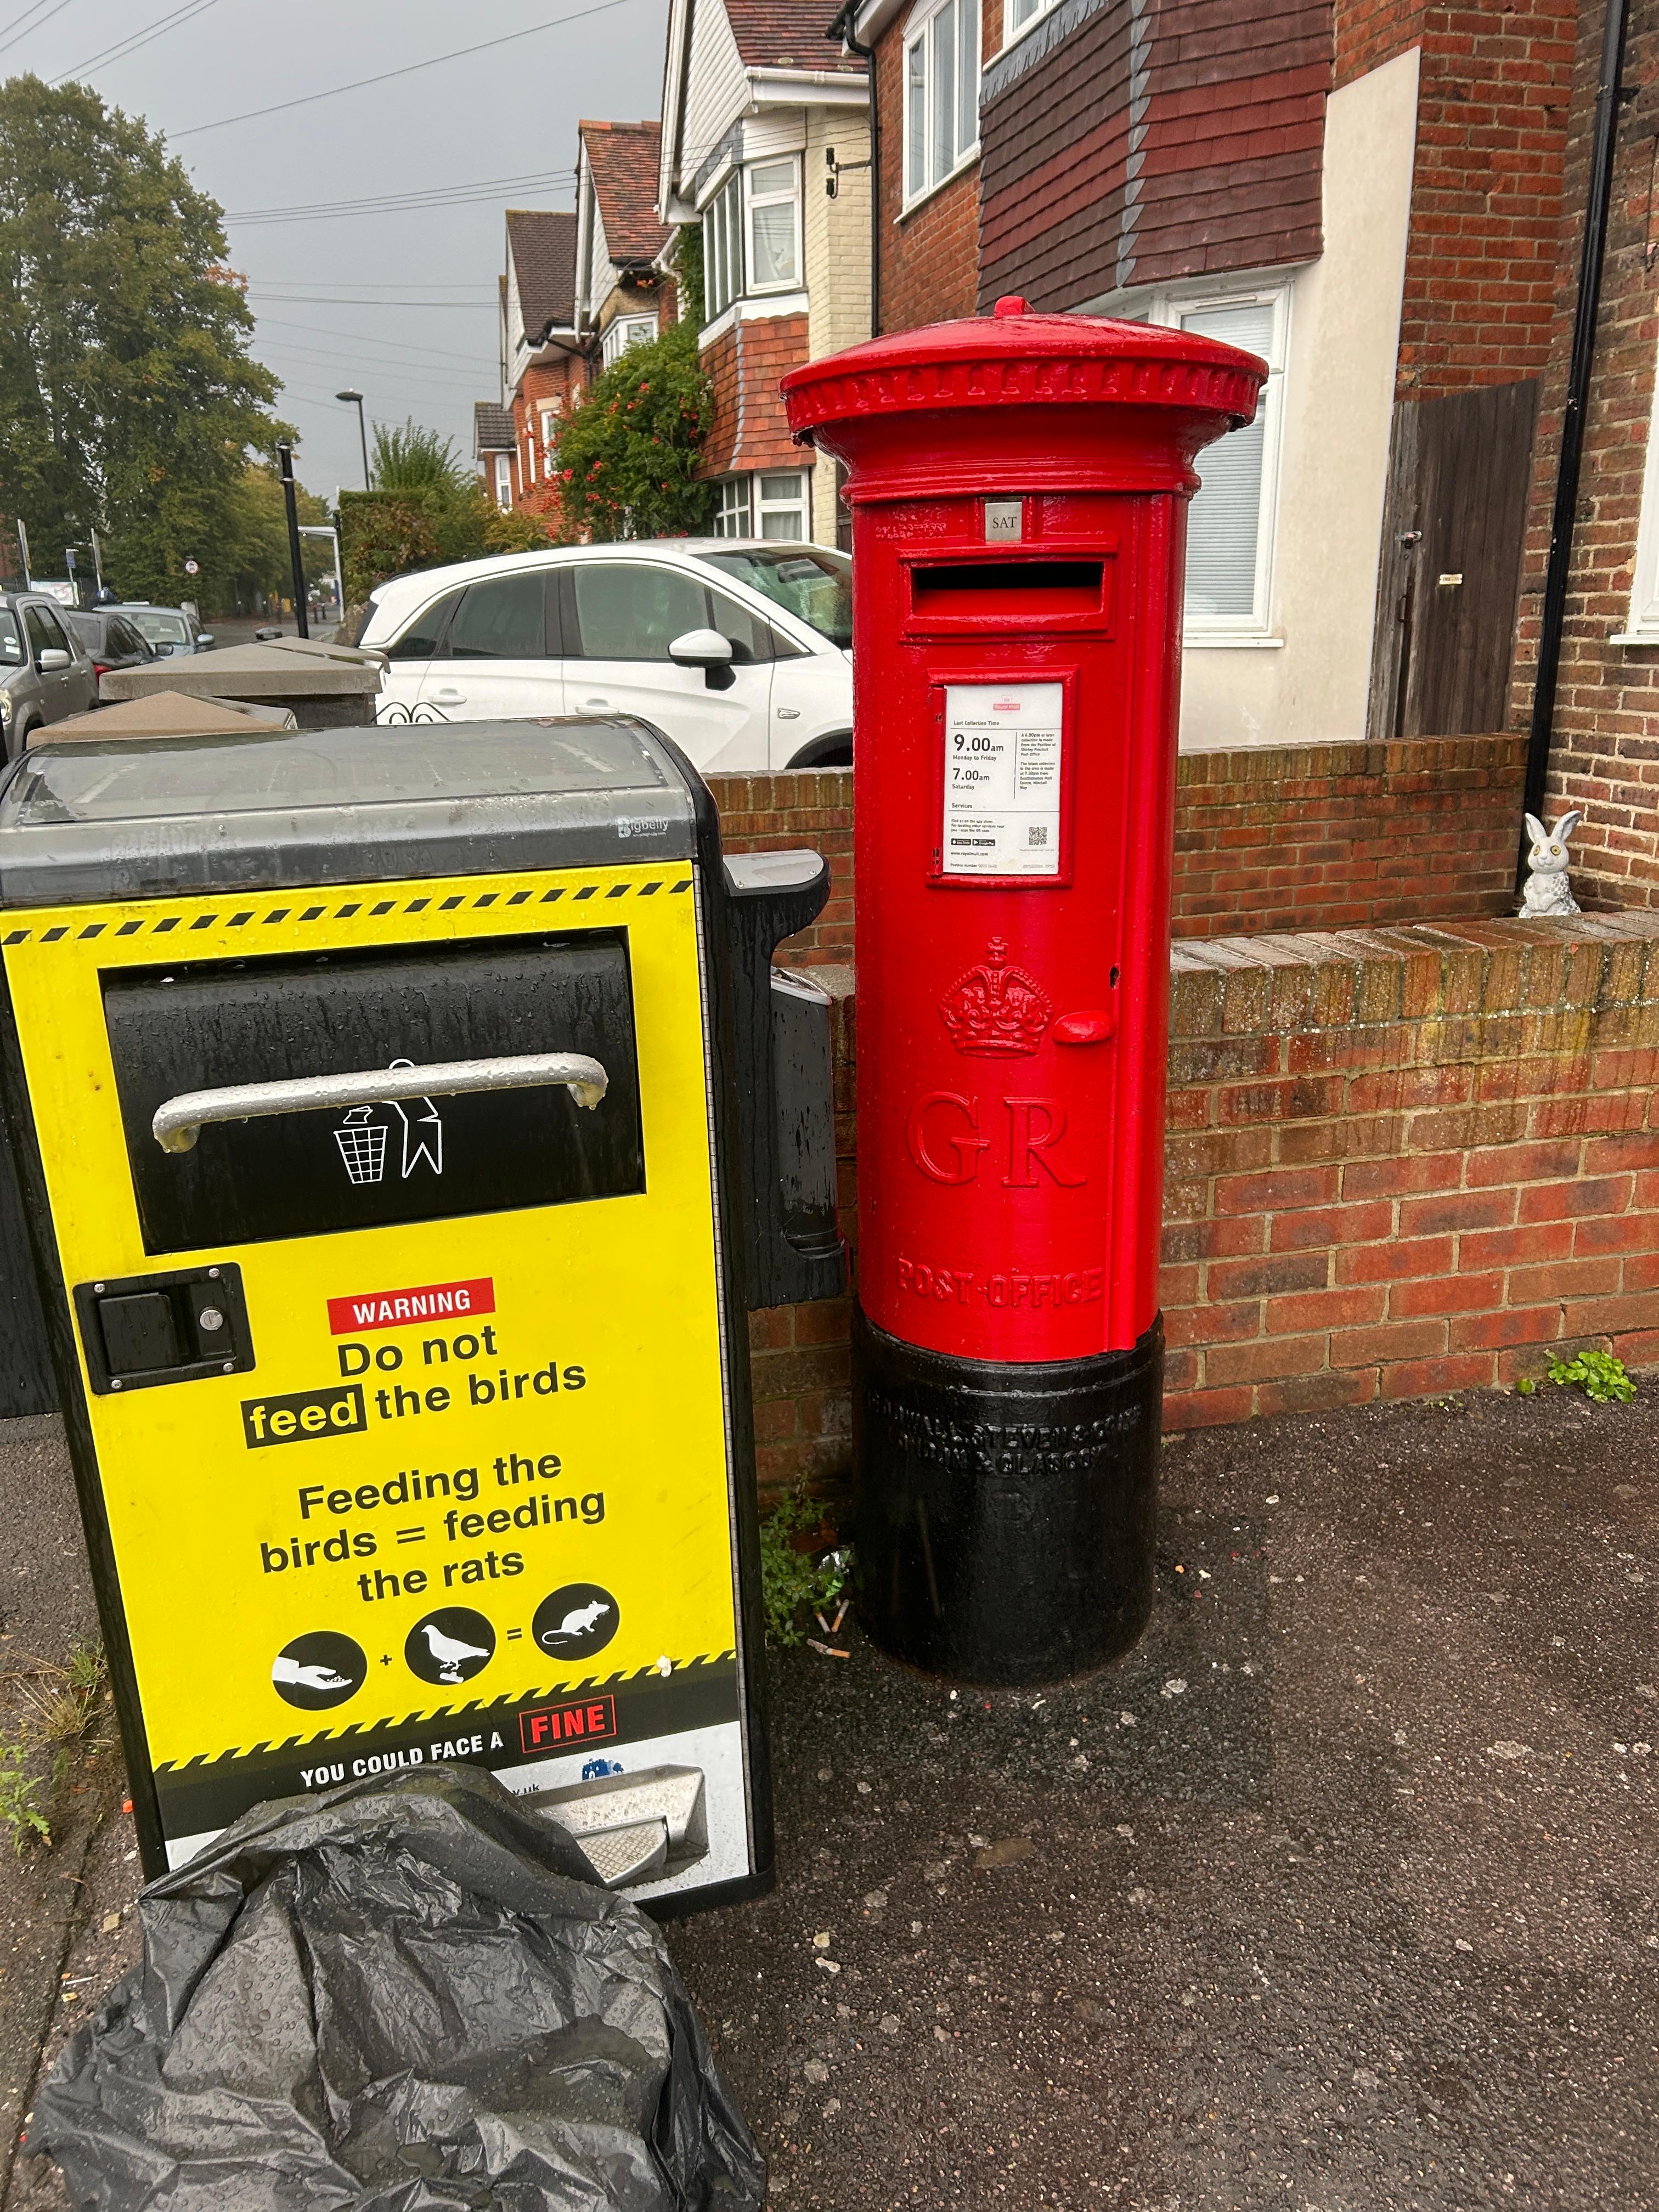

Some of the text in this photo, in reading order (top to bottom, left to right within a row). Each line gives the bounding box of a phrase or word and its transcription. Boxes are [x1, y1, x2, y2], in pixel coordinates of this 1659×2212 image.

[992, 516, 1017, 529] SAT
[954, 733, 1004, 752] 9.00am
[952, 768, 990, 781] 7.00am
[617, 817, 669, 838] Bigbelly
[352, 1288, 471, 1325] WARNING
[898, 1257, 1103, 1308] POST OFFICE
[337, 1324, 498, 1378] Do not
[249, 1361, 587, 1440] feed the birds
[298, 1452, 562, 1520] Feeding the
[259, 1528, 378, 1573] birds
[442, 1491, 605, 1542] feeding
[357, 1549, 524, 1602] the rats
[300, 1703, 607, 1788] YOU COULD FACE A FINE
